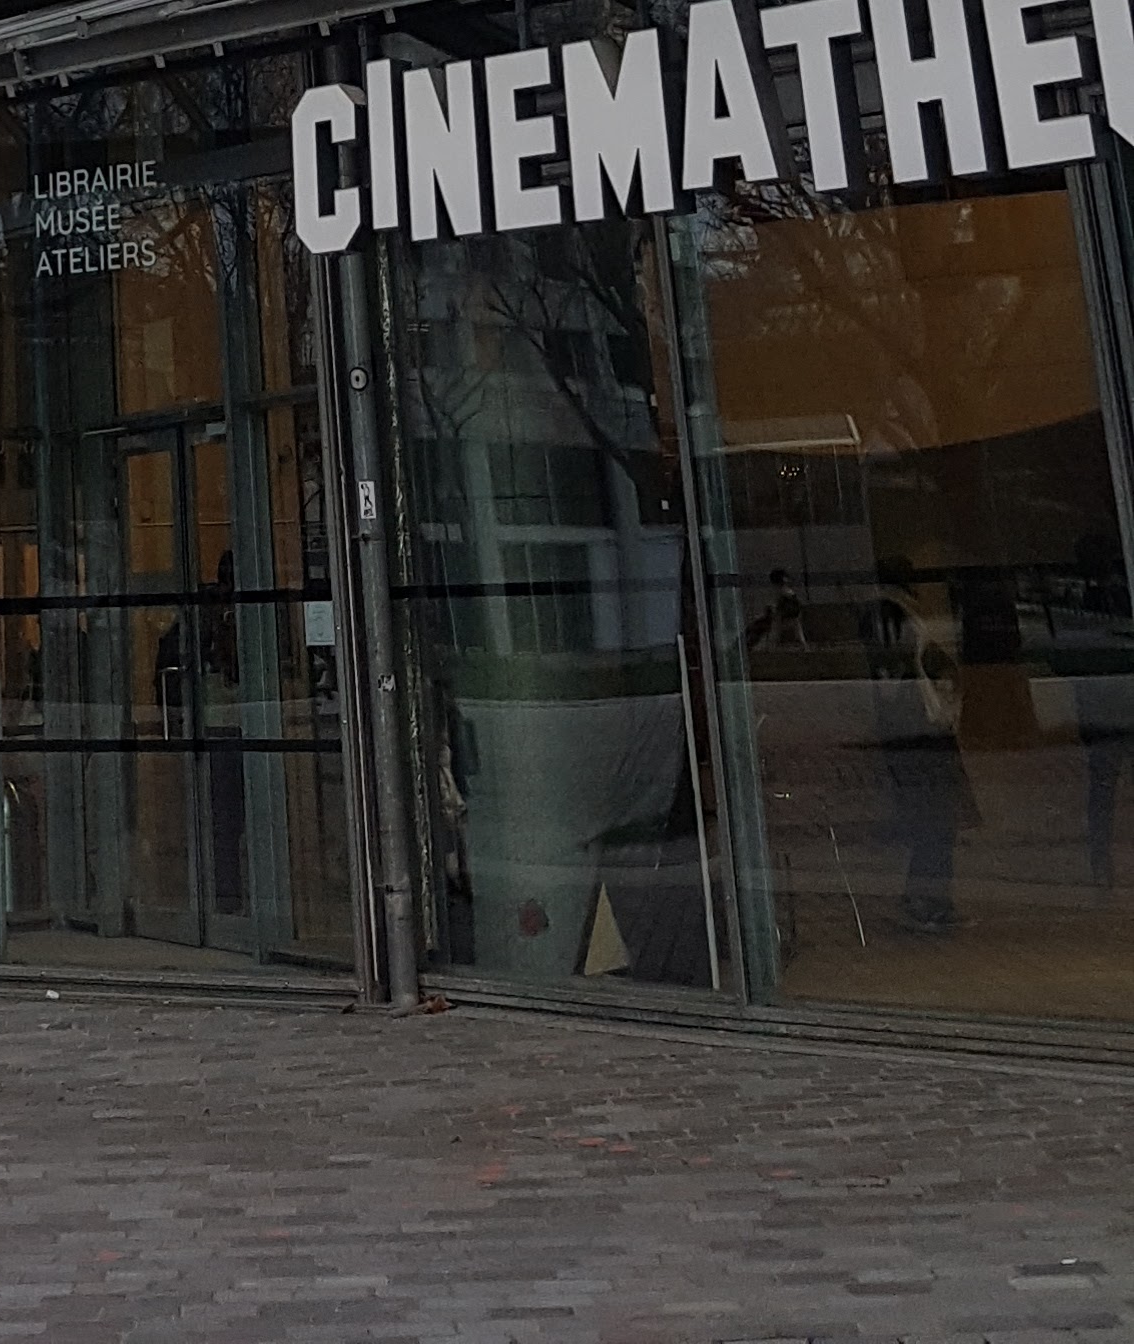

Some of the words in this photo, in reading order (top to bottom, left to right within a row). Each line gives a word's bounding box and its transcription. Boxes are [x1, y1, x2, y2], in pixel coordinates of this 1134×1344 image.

[34, 160, 158, 200] LIBRAIRIE
[35, 198, 123, 238] MUSÉE
[35, 239, 157, 278] ATELIERS
